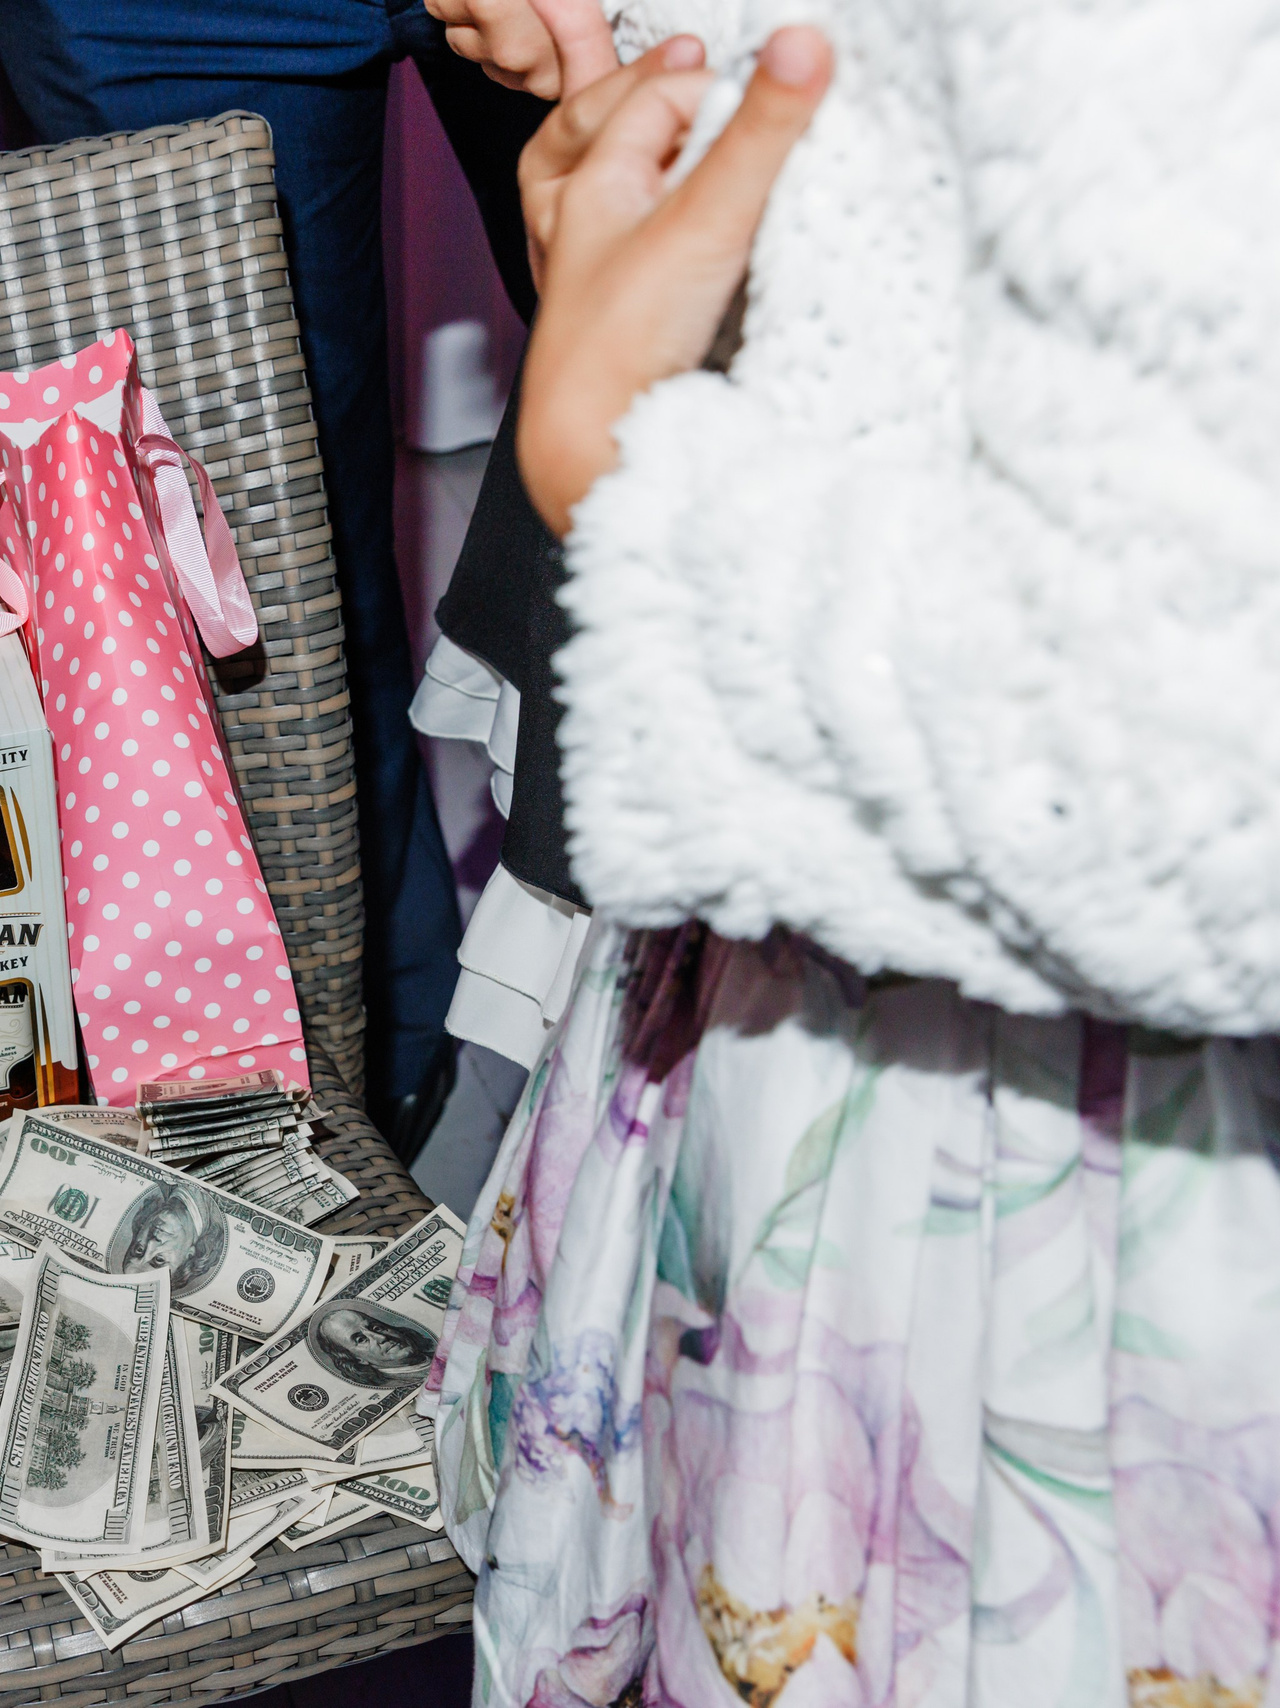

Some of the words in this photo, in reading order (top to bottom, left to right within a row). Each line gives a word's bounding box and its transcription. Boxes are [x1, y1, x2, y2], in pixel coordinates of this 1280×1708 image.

[27, 1133, 81, 1169] 100
[28, 1118, 84, 1152] DOLLARS
[81, 1138, 140, 1173] HUNDRED
[138, 1164, 163, 1181] ONE
[247, 1212, 310, 1253] 100
[384, 1218, 441, 1266] 100
[368, 1266, 410, 1302] UNITED
[404, 1237, 446, 1273] STATES
[397, 1249, 447, 1291] AMERICA
[35, 1310, 50, 1337] ONE
[136, 1315, 150, 1342] THE
[21, 1335, 46, 1403] HUNDRED
[121, 1363, 128, 1372] IN
[130, 1341, 147, 1386] UNITED
[232, 1334, 293, 1385] 100
[253, 1379, 267, 1392] THIS
[266, 1370, 280, 1383] NOTE
[284, 1359, 295, 1369] NOT
[263, 1376, 280, 1391] LEGAL
[277, 1362, 298, 1380] TENDER
[118, 1374, 126, 1392] GOD
[123, 1385, 141, 1431] STATES
[329, 1398, 385, 1446] 100
[7, 1400, 35, 1468] DOLLARS
[112, 1421, 120, 1434] WE
[160, 1404, 181, 1464] HUNDRED
[108, 1435, 118, 1460] TRUST
[113, 1446, 133, 1509] AMERICA
[167, 1463, 183, 1490] ONE
[370, 1471, 432, 1503] 100
[363, 1487, 425, 1514] DOLLARS
